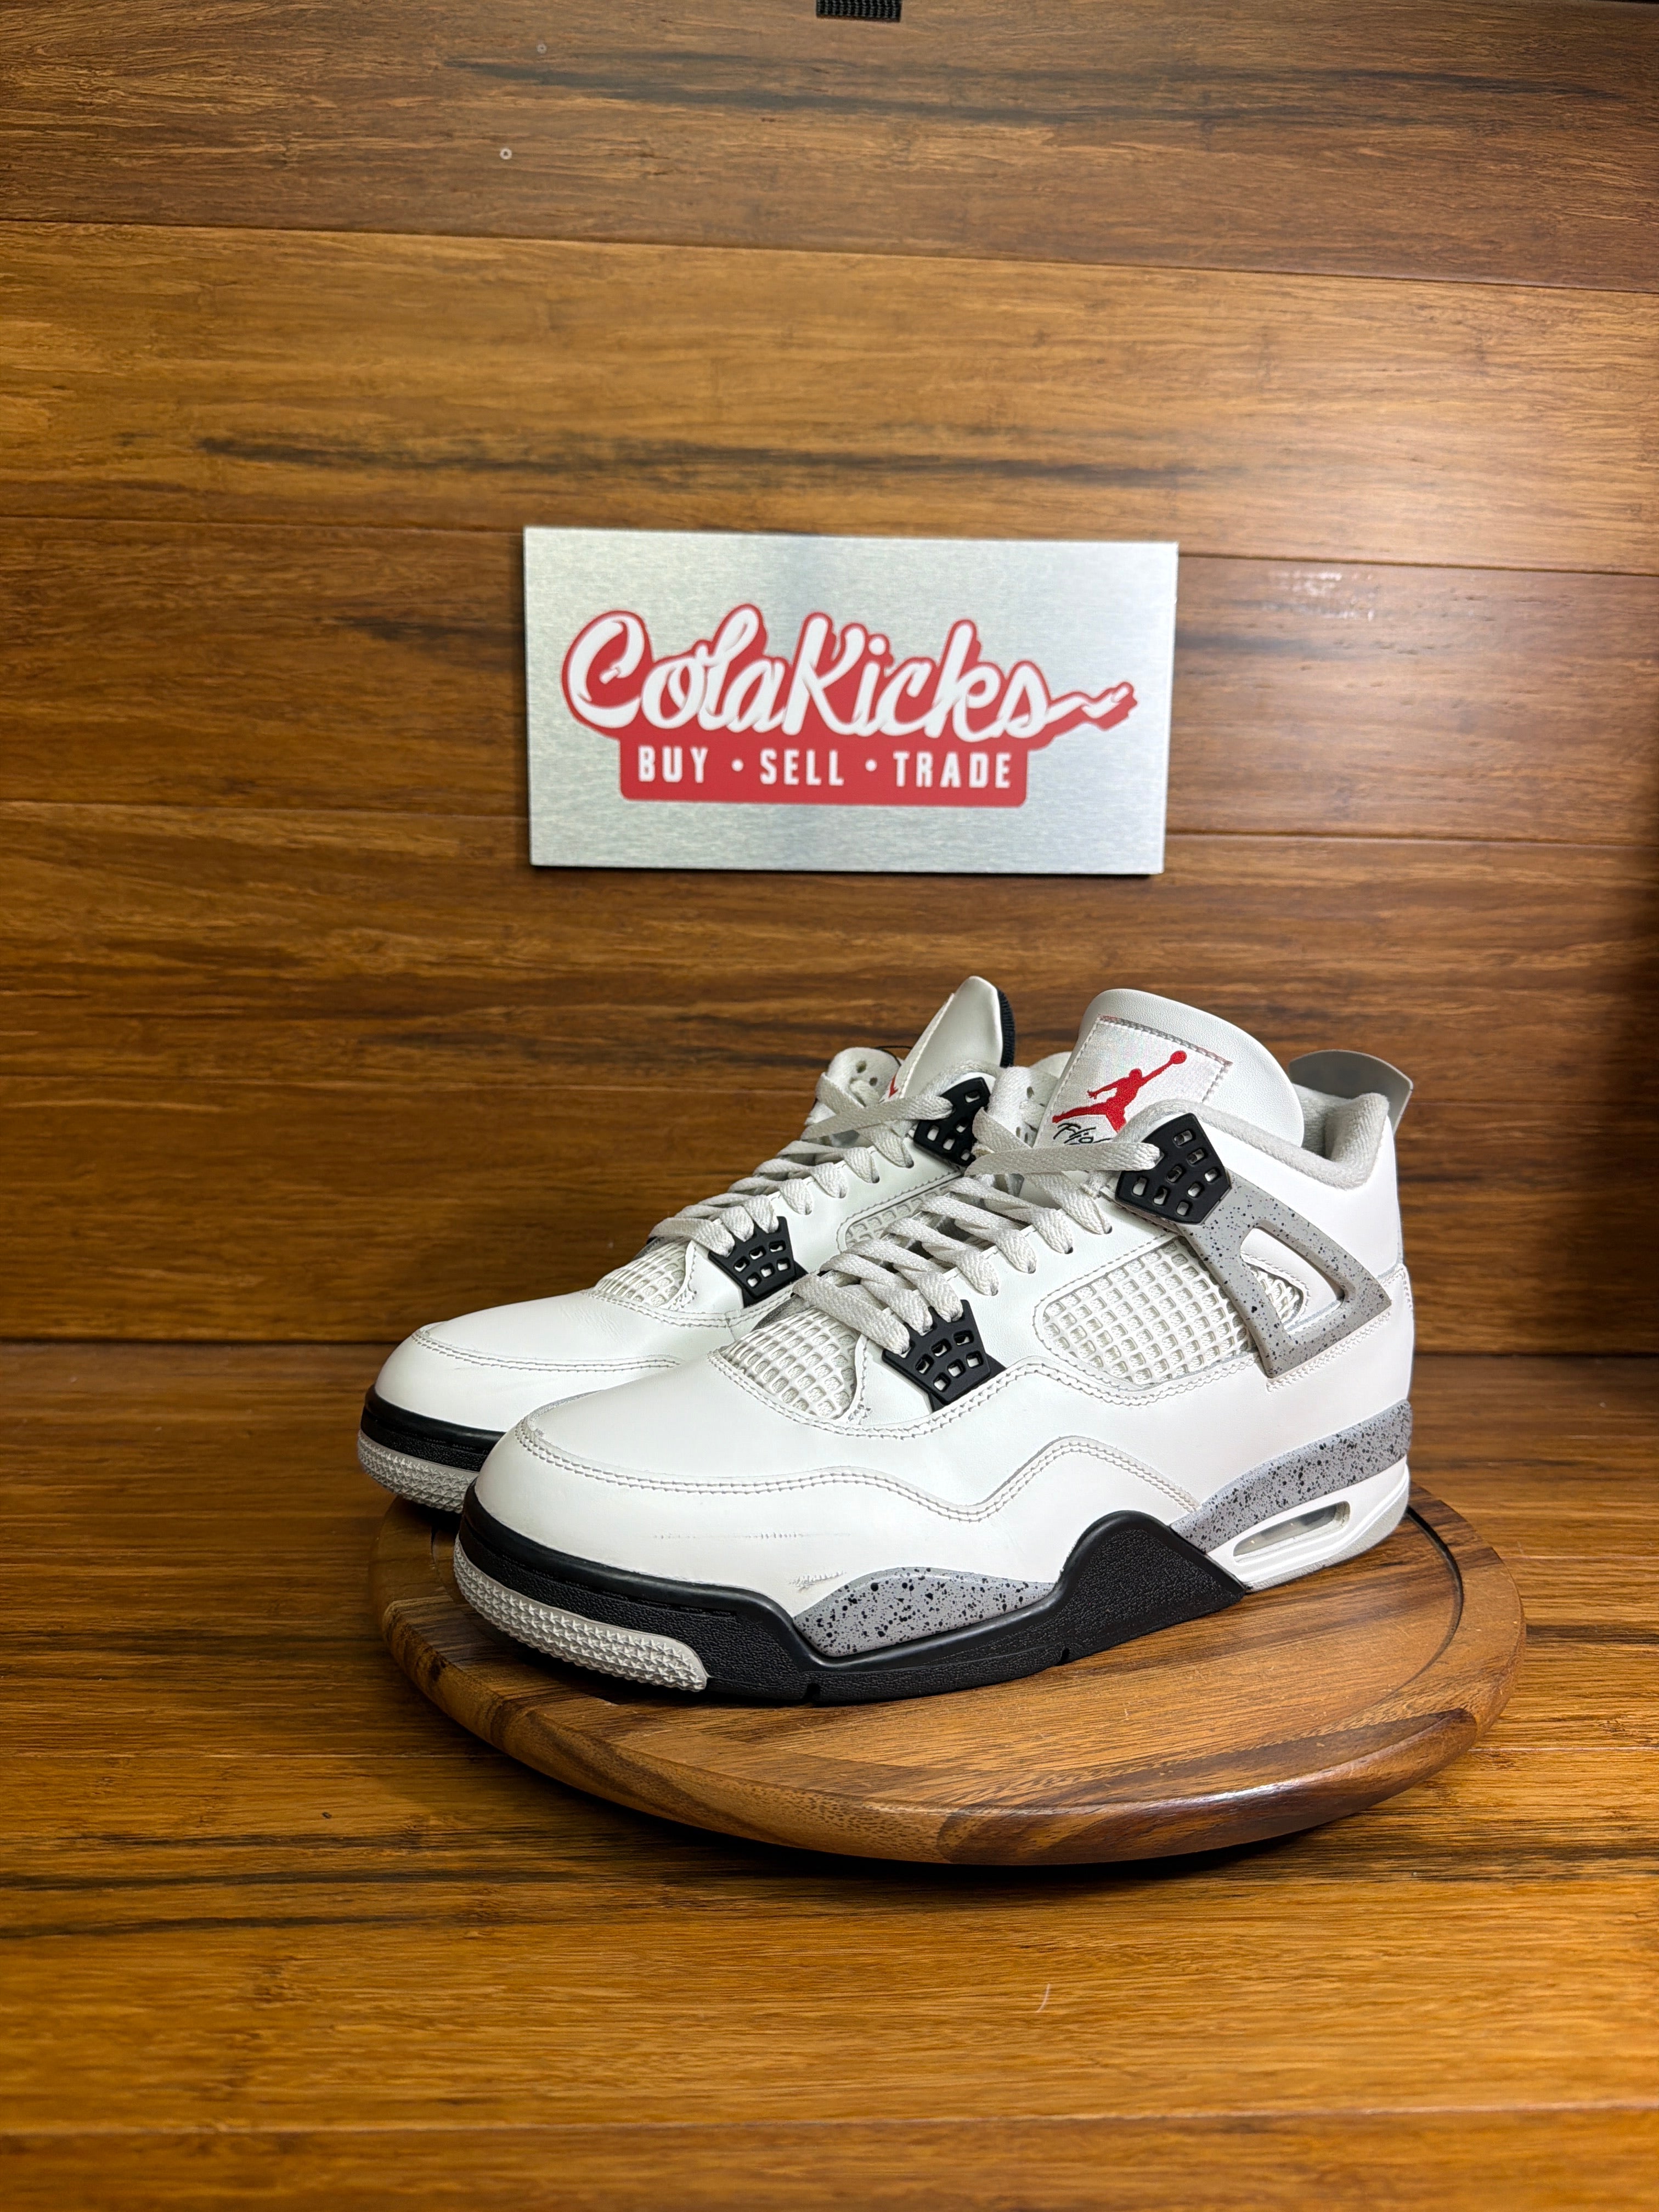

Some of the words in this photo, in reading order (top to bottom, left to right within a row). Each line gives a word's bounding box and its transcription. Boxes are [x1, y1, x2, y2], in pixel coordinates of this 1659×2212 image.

[564, 603, 1133, 743] ColaKicks
[638, 745, 708, 783] BUY
[759, 748, 844, 786] SELL
[892, 751, 1012, 789] TRADE
